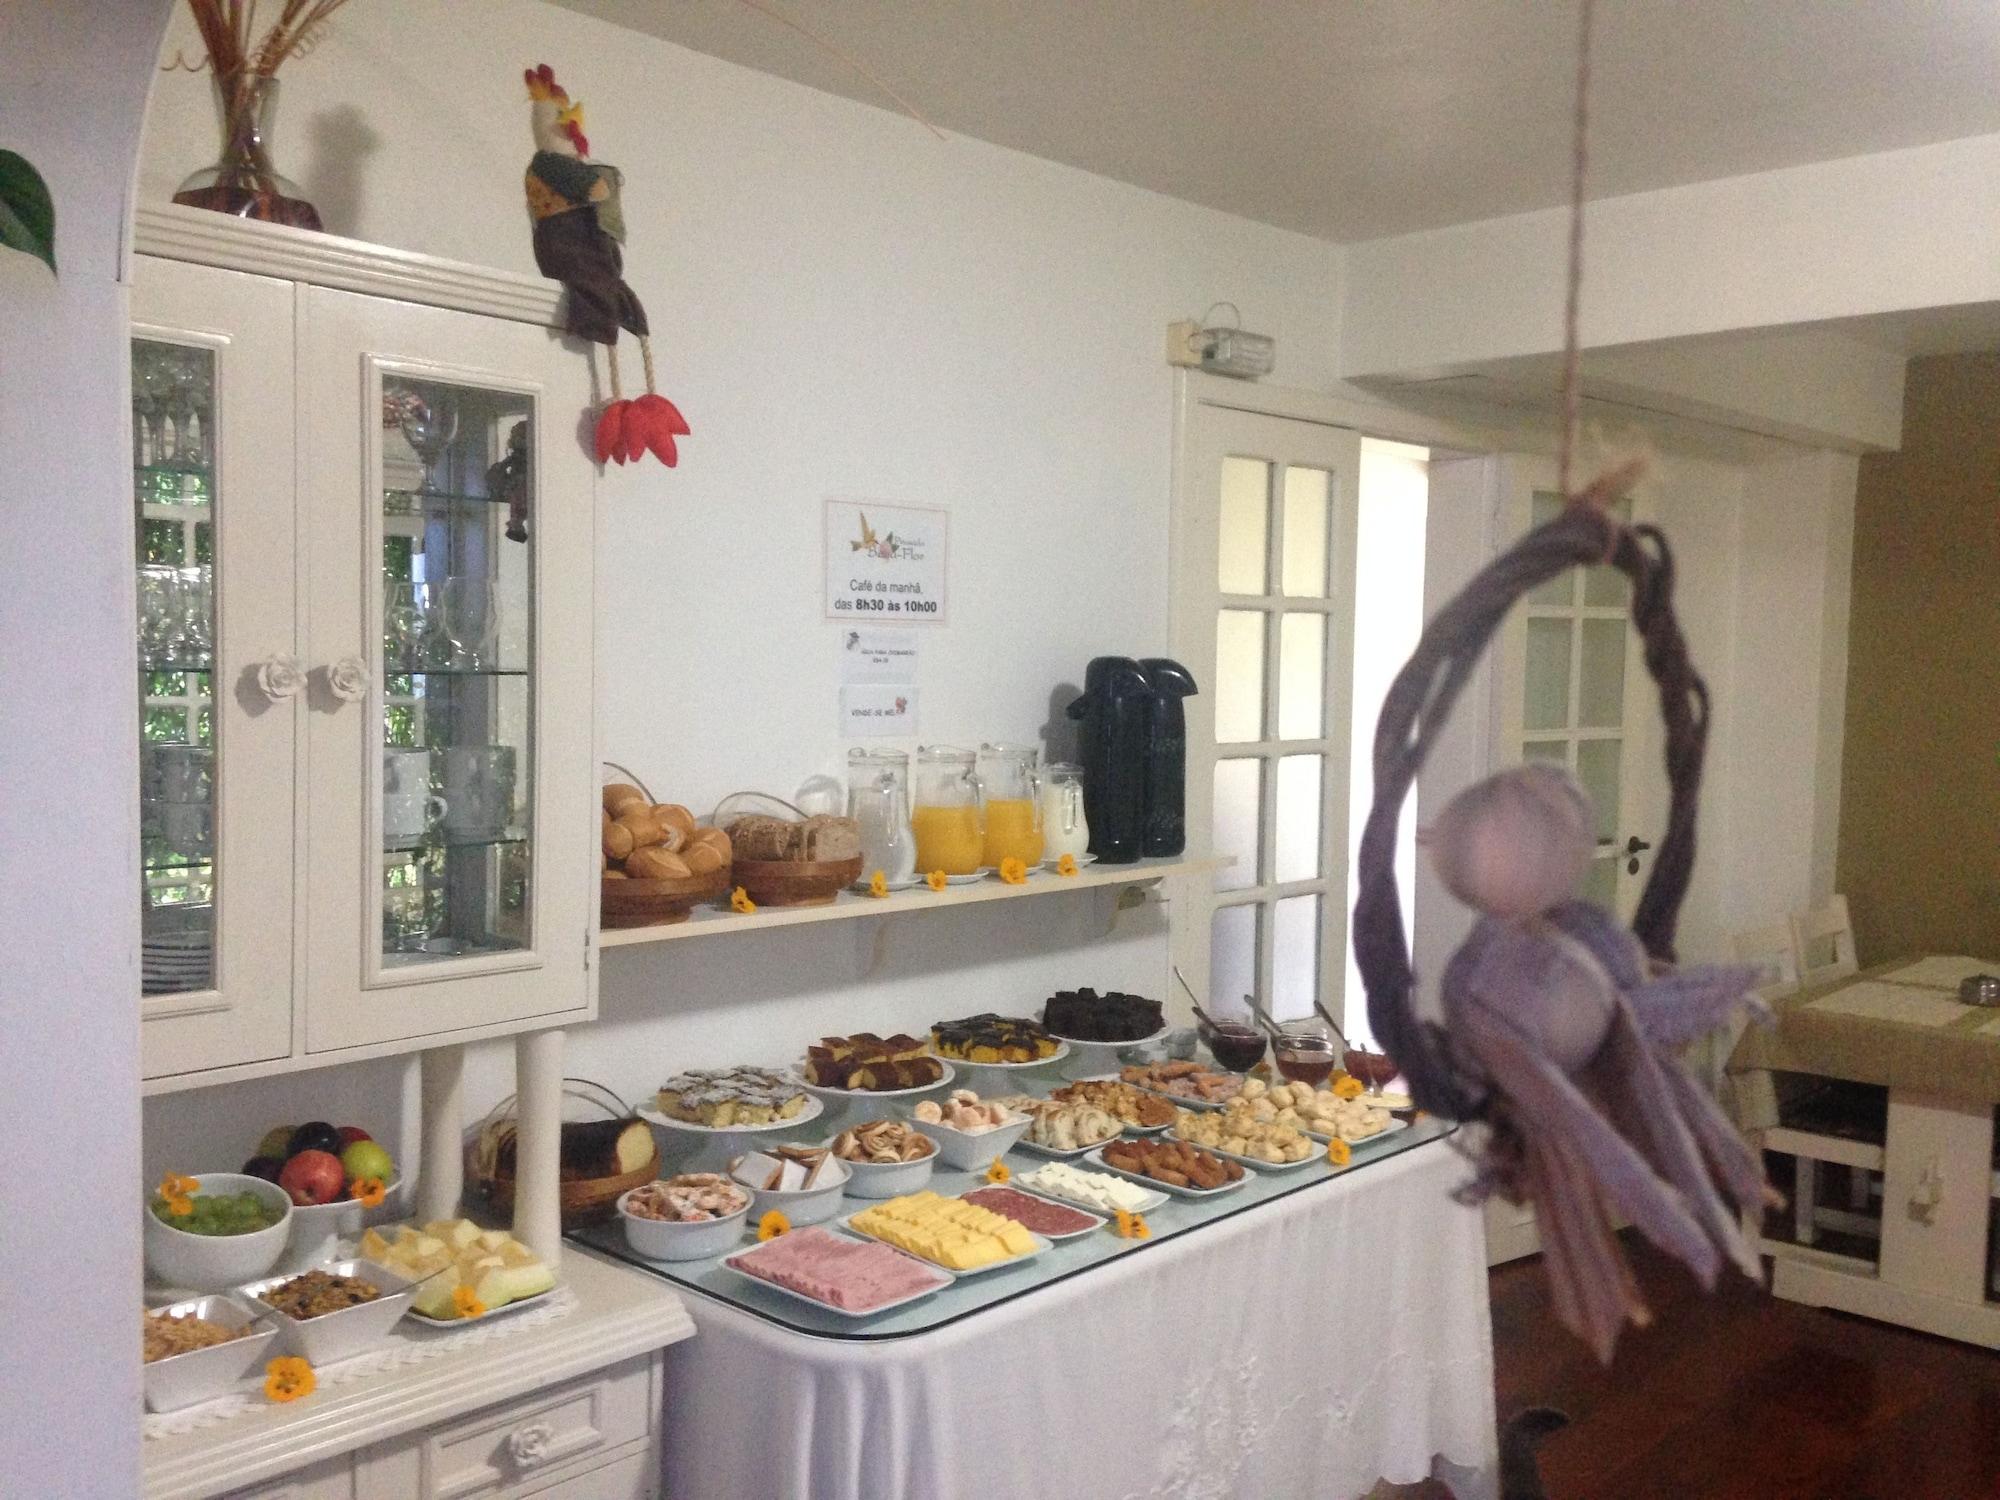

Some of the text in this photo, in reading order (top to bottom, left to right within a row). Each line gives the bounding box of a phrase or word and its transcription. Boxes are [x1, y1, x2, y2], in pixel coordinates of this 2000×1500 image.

[849, 579, 873, 592] Café
[875, 580, 887, 592] da
[834, 598, 852, 610] das
[855, 598, 884, 611] 8h30
[904, 600, 937, 613] 10h00
